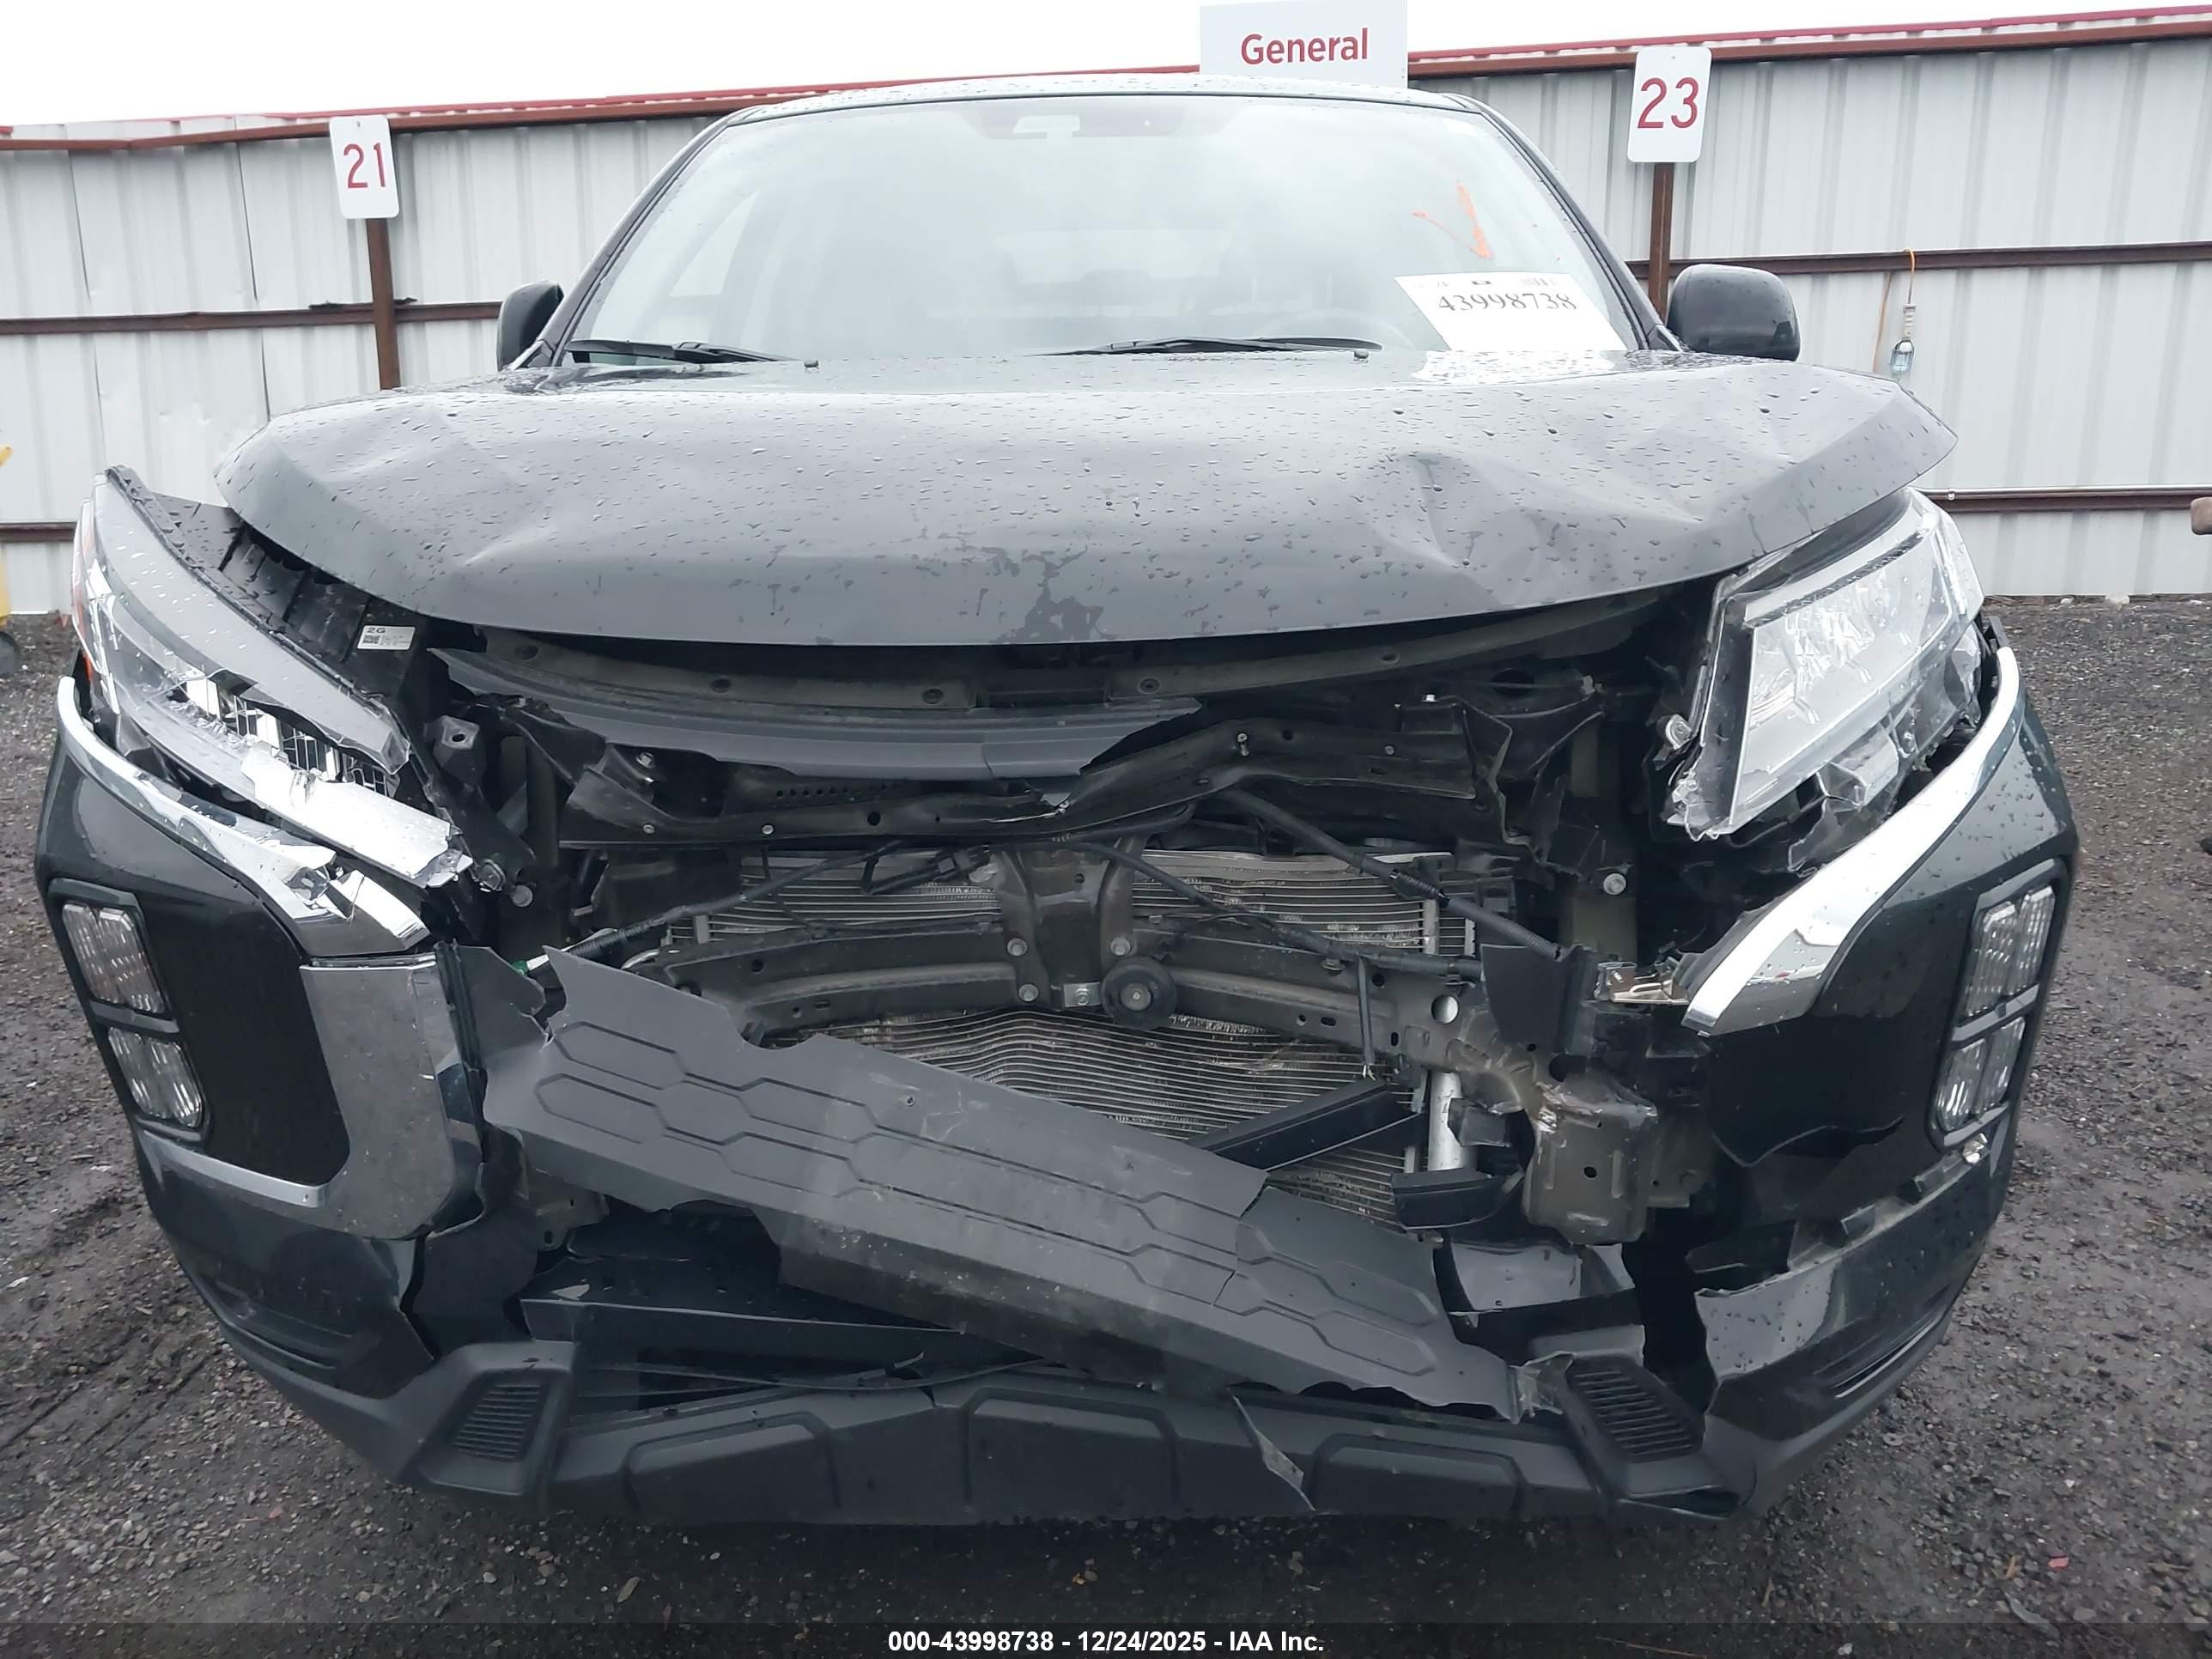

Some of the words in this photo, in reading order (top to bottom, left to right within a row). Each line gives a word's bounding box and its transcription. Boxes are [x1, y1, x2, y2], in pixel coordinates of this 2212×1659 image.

[1241, 27, 1368, 64] General
[1638, 77, 1699, 129] 23
[343, 143, 386, 188] 21
[1437, 293, 1577, 311] 43998738
